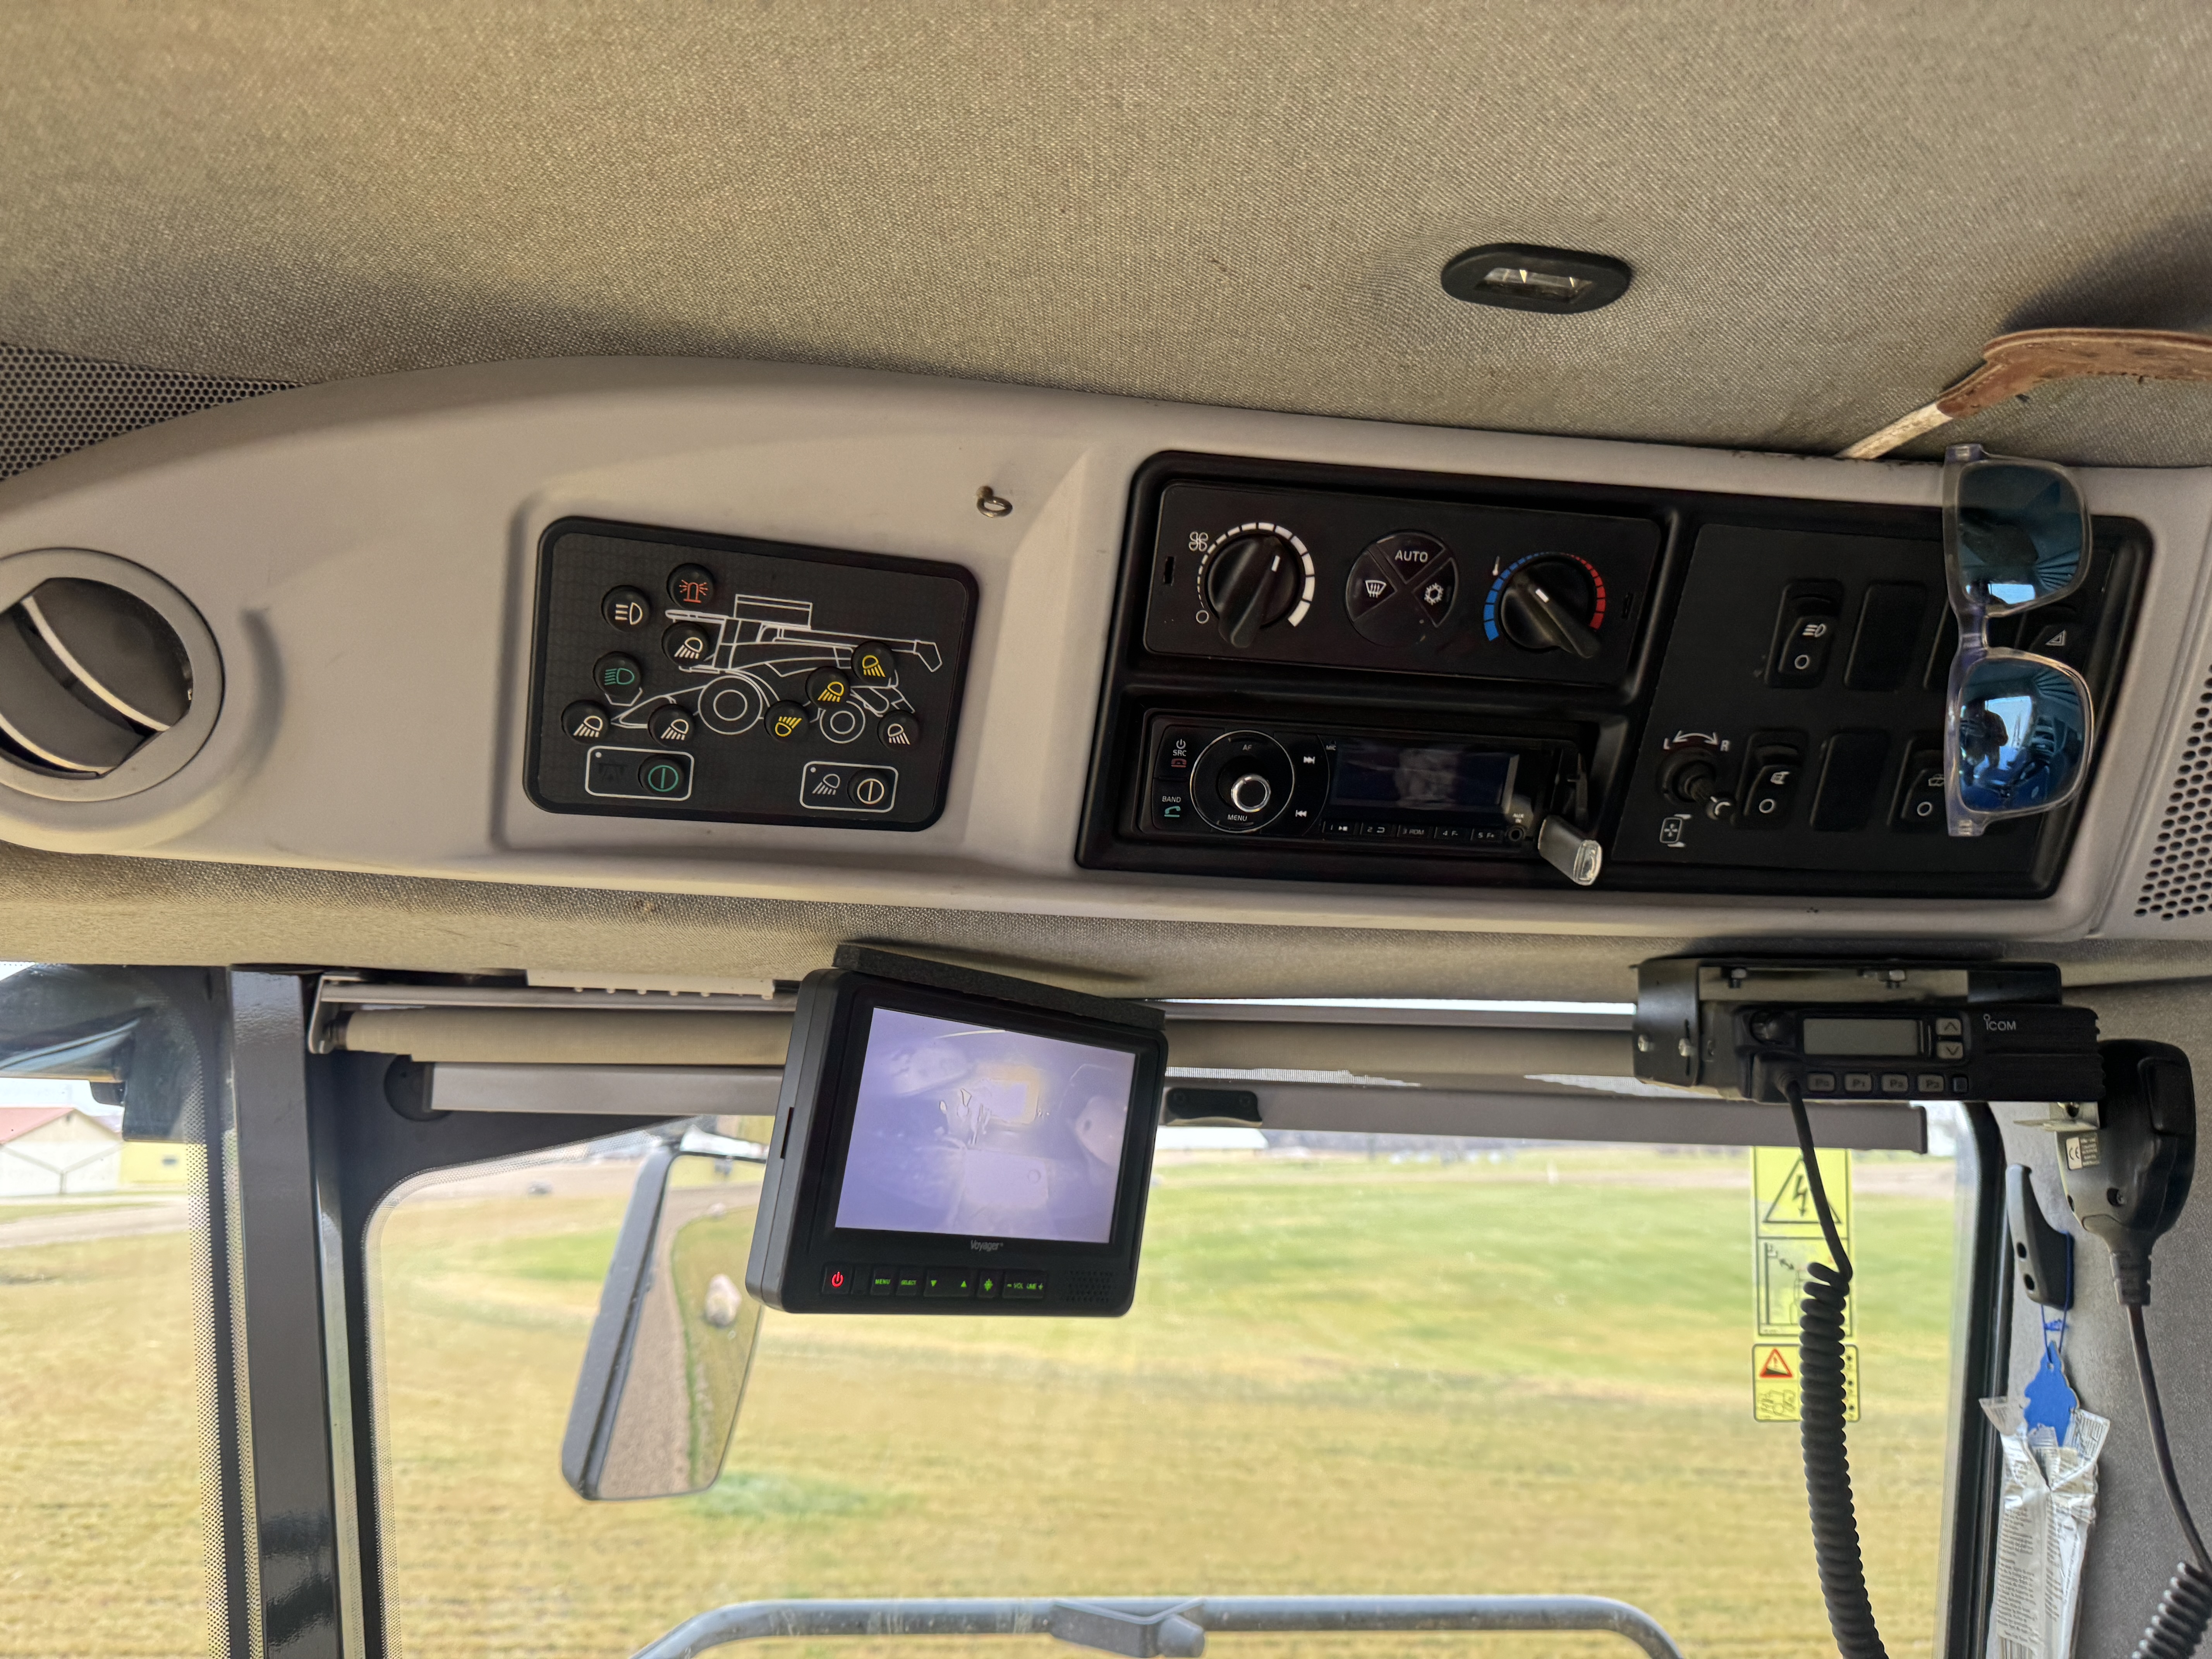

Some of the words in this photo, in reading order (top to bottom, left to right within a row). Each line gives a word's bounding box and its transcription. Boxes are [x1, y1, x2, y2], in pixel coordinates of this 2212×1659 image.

[1395, 550, 1428, 563] AUTO
[1663, 738, 1670, 750] L
[1720, 740, 1729, 751] R
[970, 1239, 1000, 1252] Voyager
